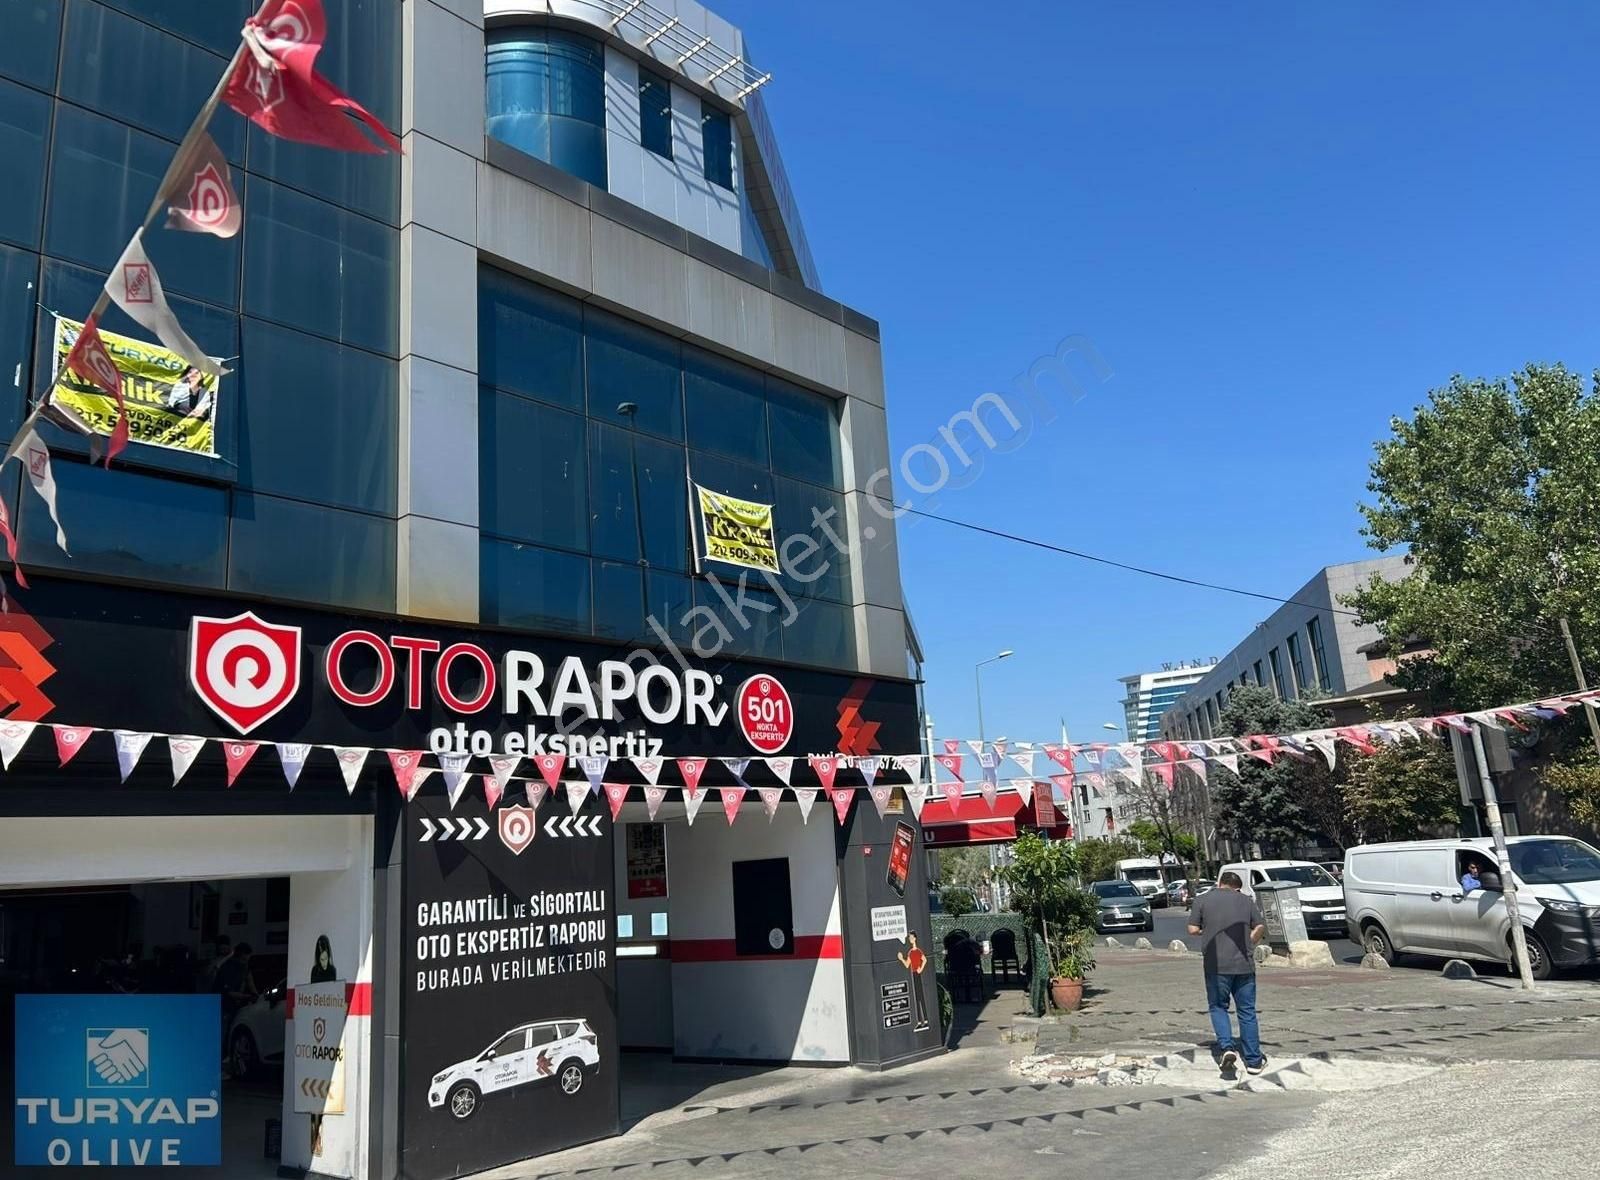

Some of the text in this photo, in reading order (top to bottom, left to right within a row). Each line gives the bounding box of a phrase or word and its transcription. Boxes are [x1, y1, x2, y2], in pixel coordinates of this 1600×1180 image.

[107, 415, 140, 433] 59
[748, 696, 784, 723] 501
[751, 731, 784, 742] EKSPERTİZ
[756, 723, 778, 732] NOKTA
[429, 722, 664, 768] oto ekspertiz
[417, 890, 605, 927] GARANTİLİ VE SİGORTALI
[417, 919, 606, 961] OTO EKSPERTİZ RAPORU
[417, 948, 606, 992] BURADA VERİLMEKTEDİR
